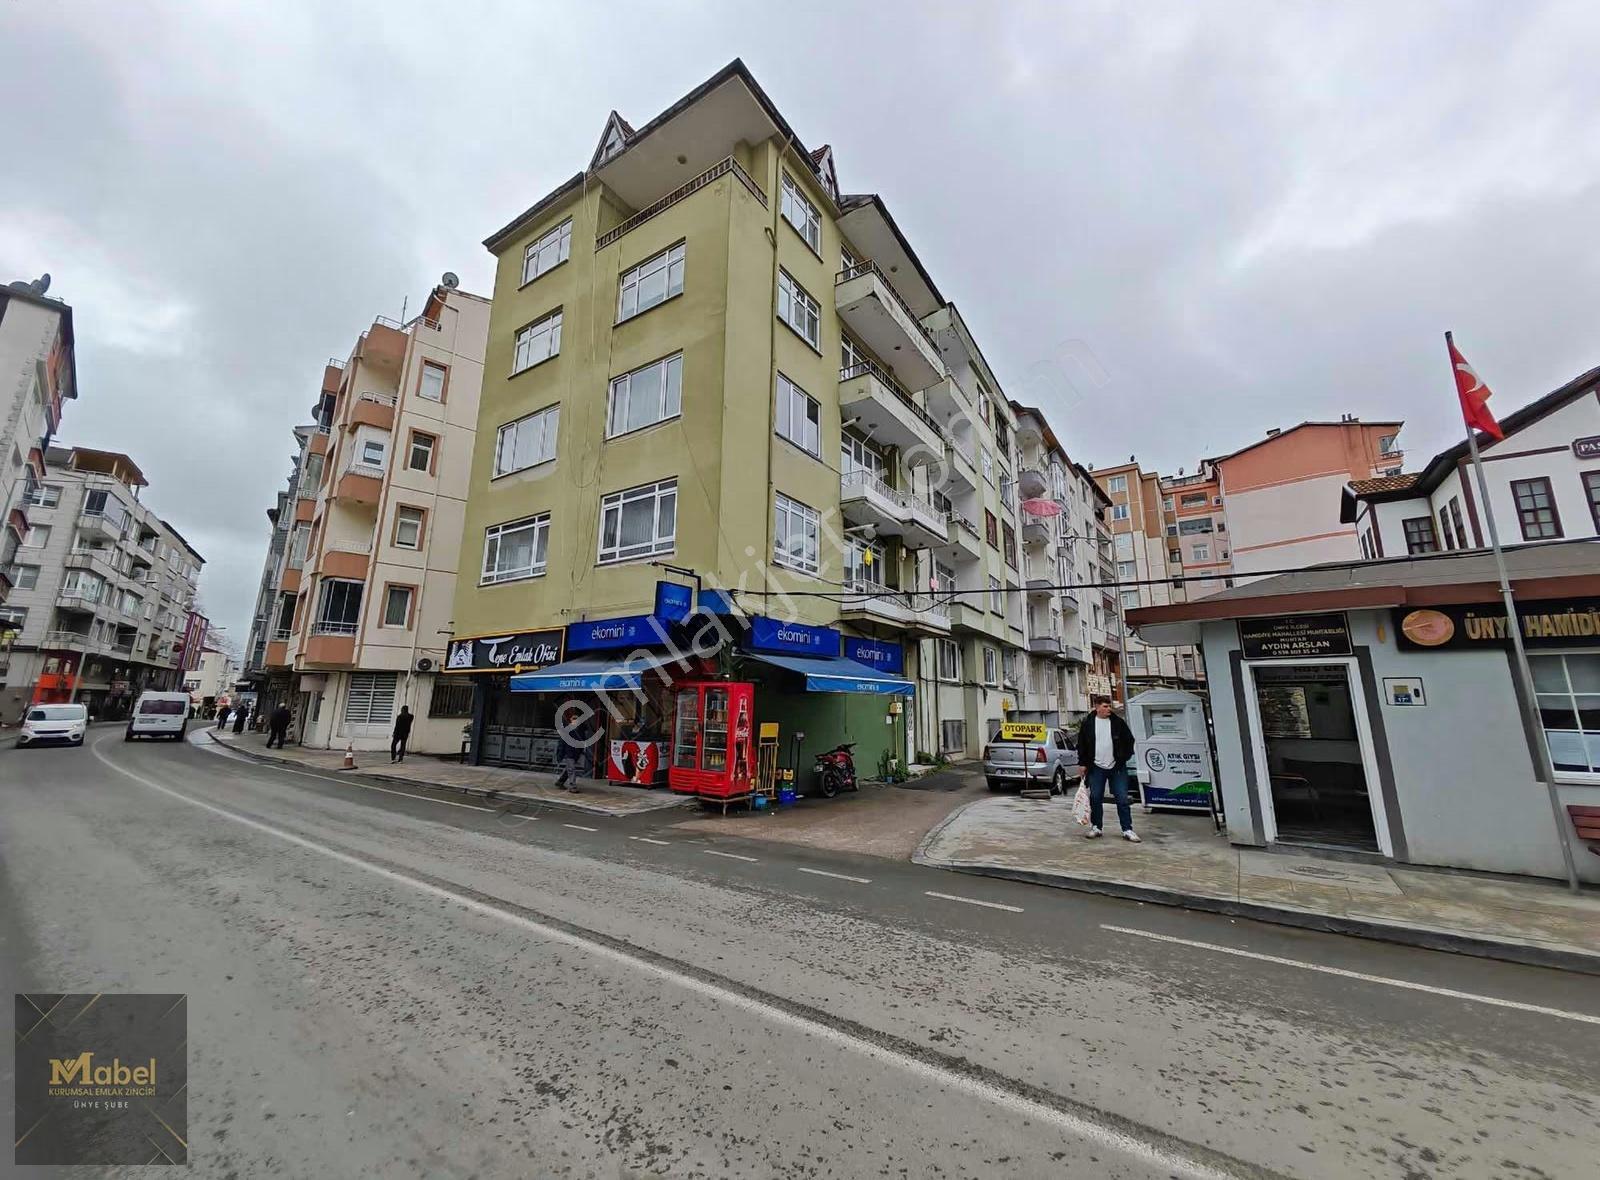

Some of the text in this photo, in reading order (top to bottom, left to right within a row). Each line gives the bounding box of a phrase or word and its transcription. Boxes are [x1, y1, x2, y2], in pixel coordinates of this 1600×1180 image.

[591, 623, 625, 640] ekomini
[777, 626, 811, 644] ekomini
[480, 635, 558, 668] Tepe Emlak Ofisi
[856, 646, 884, 661] ekomini
[1261, 641, 1330, 651] AYDIN ARSLAN
[1004, 724, 1042, 733] OTOPARK
